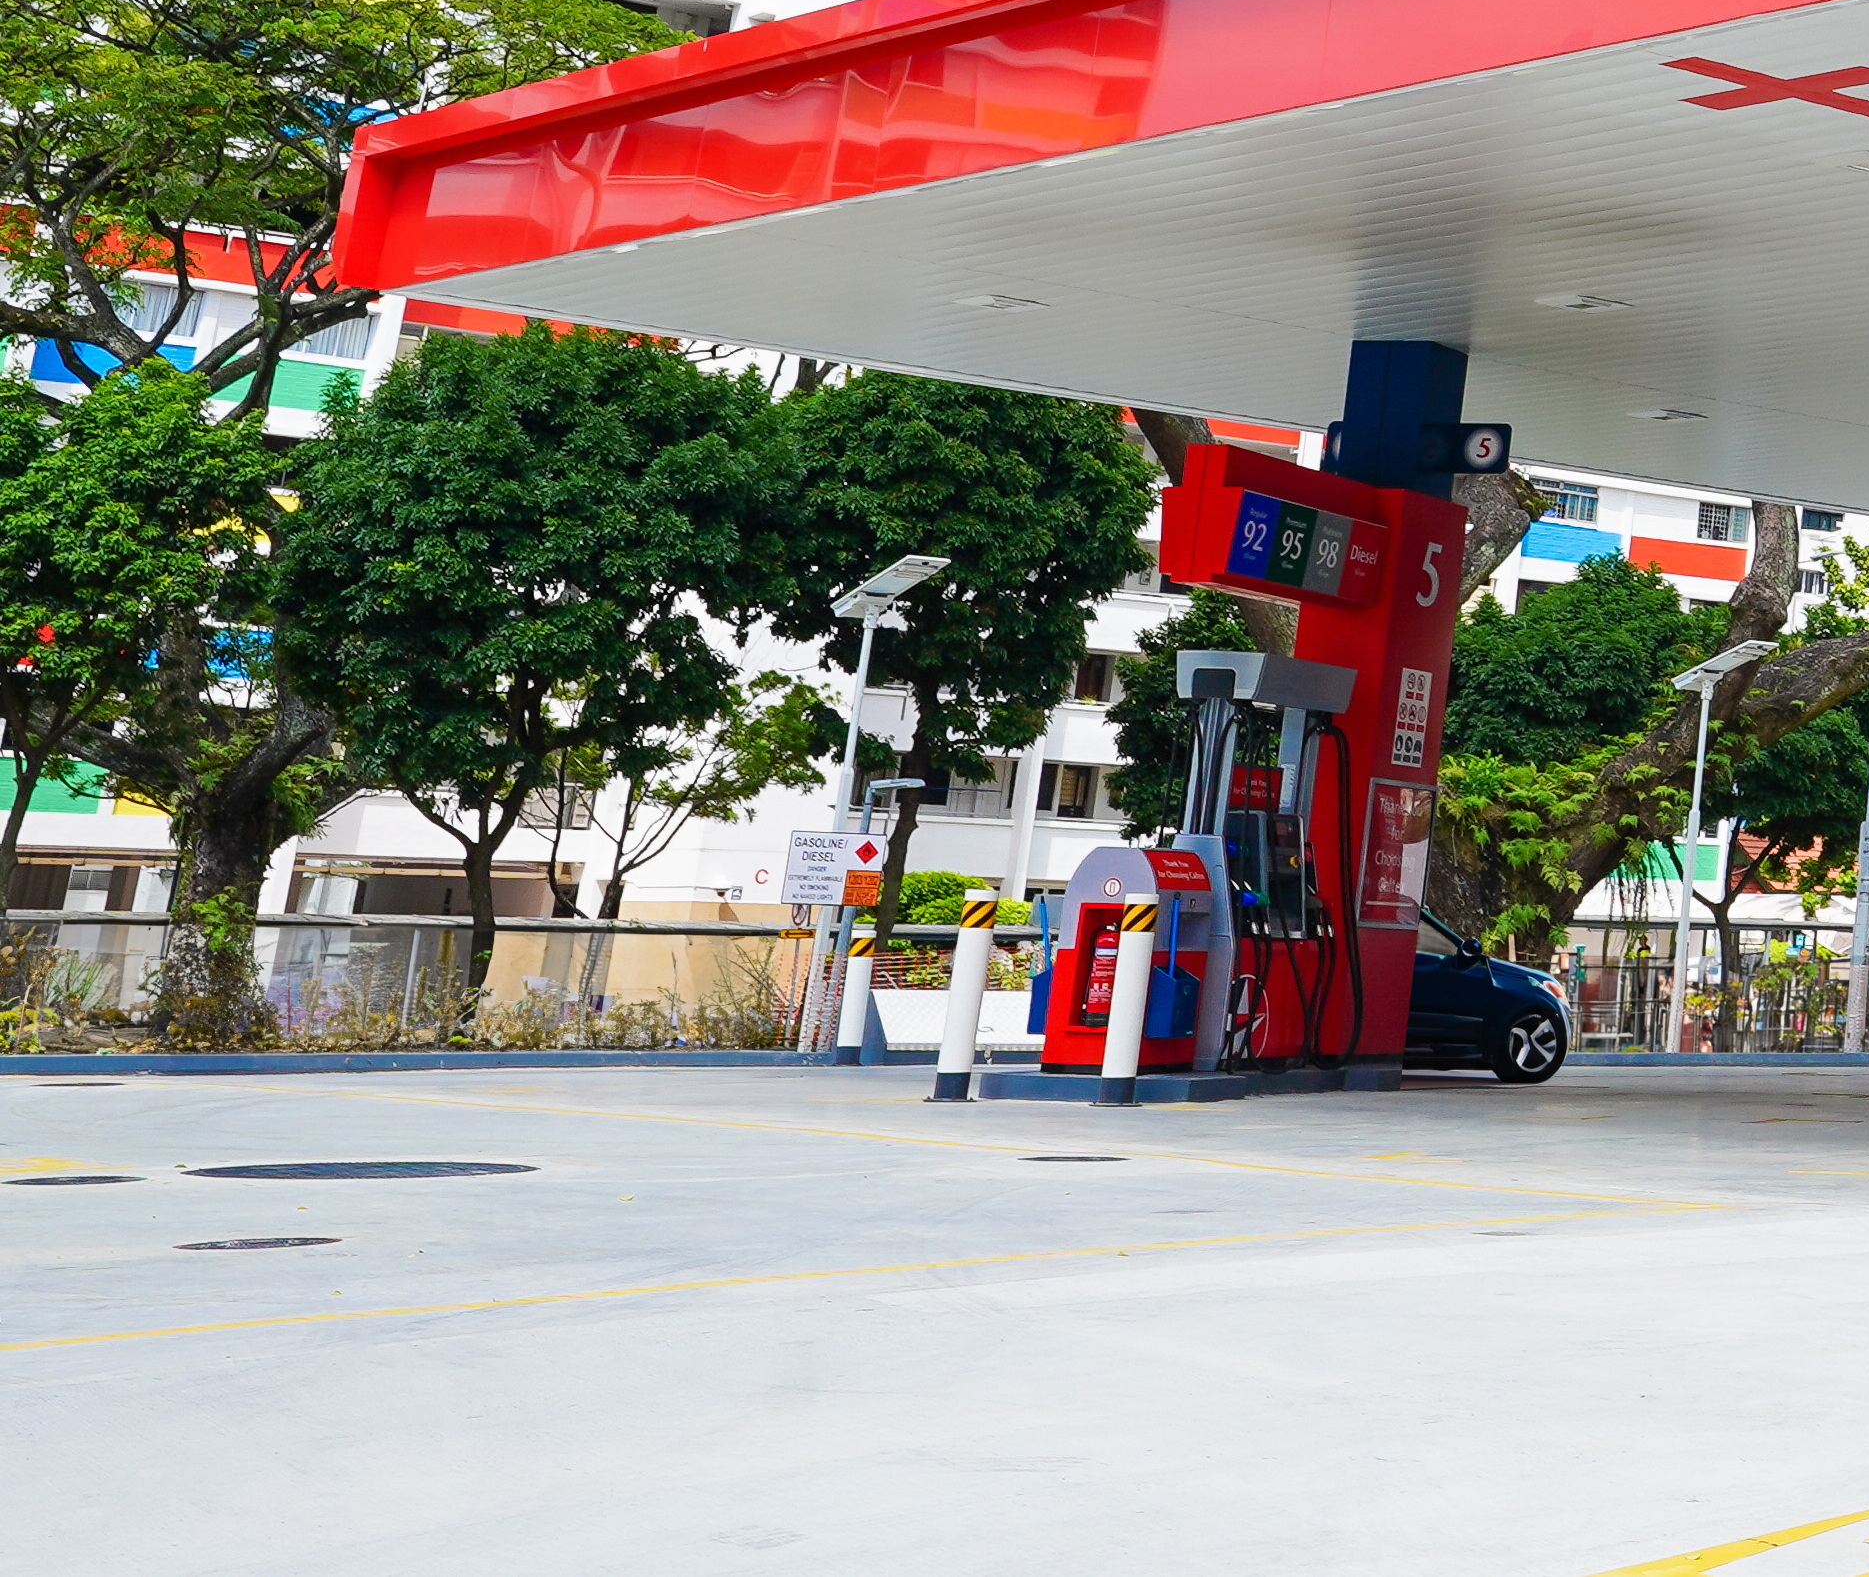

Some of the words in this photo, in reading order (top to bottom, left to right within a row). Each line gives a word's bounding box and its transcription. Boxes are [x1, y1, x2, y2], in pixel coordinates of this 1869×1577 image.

[1476, 437, 1492, 459] 5
[1242, 521, 1267, 552] 92
[1279, 530, 1304, 560] 95
[1316, 539, 1340, 569] 98
[1350, 545, 1379, 566] Diesel
[1415, 542, 1443, 608] 5
[802, 851, 835, 862] DIESEL
[755, 869, 769, 884] C
